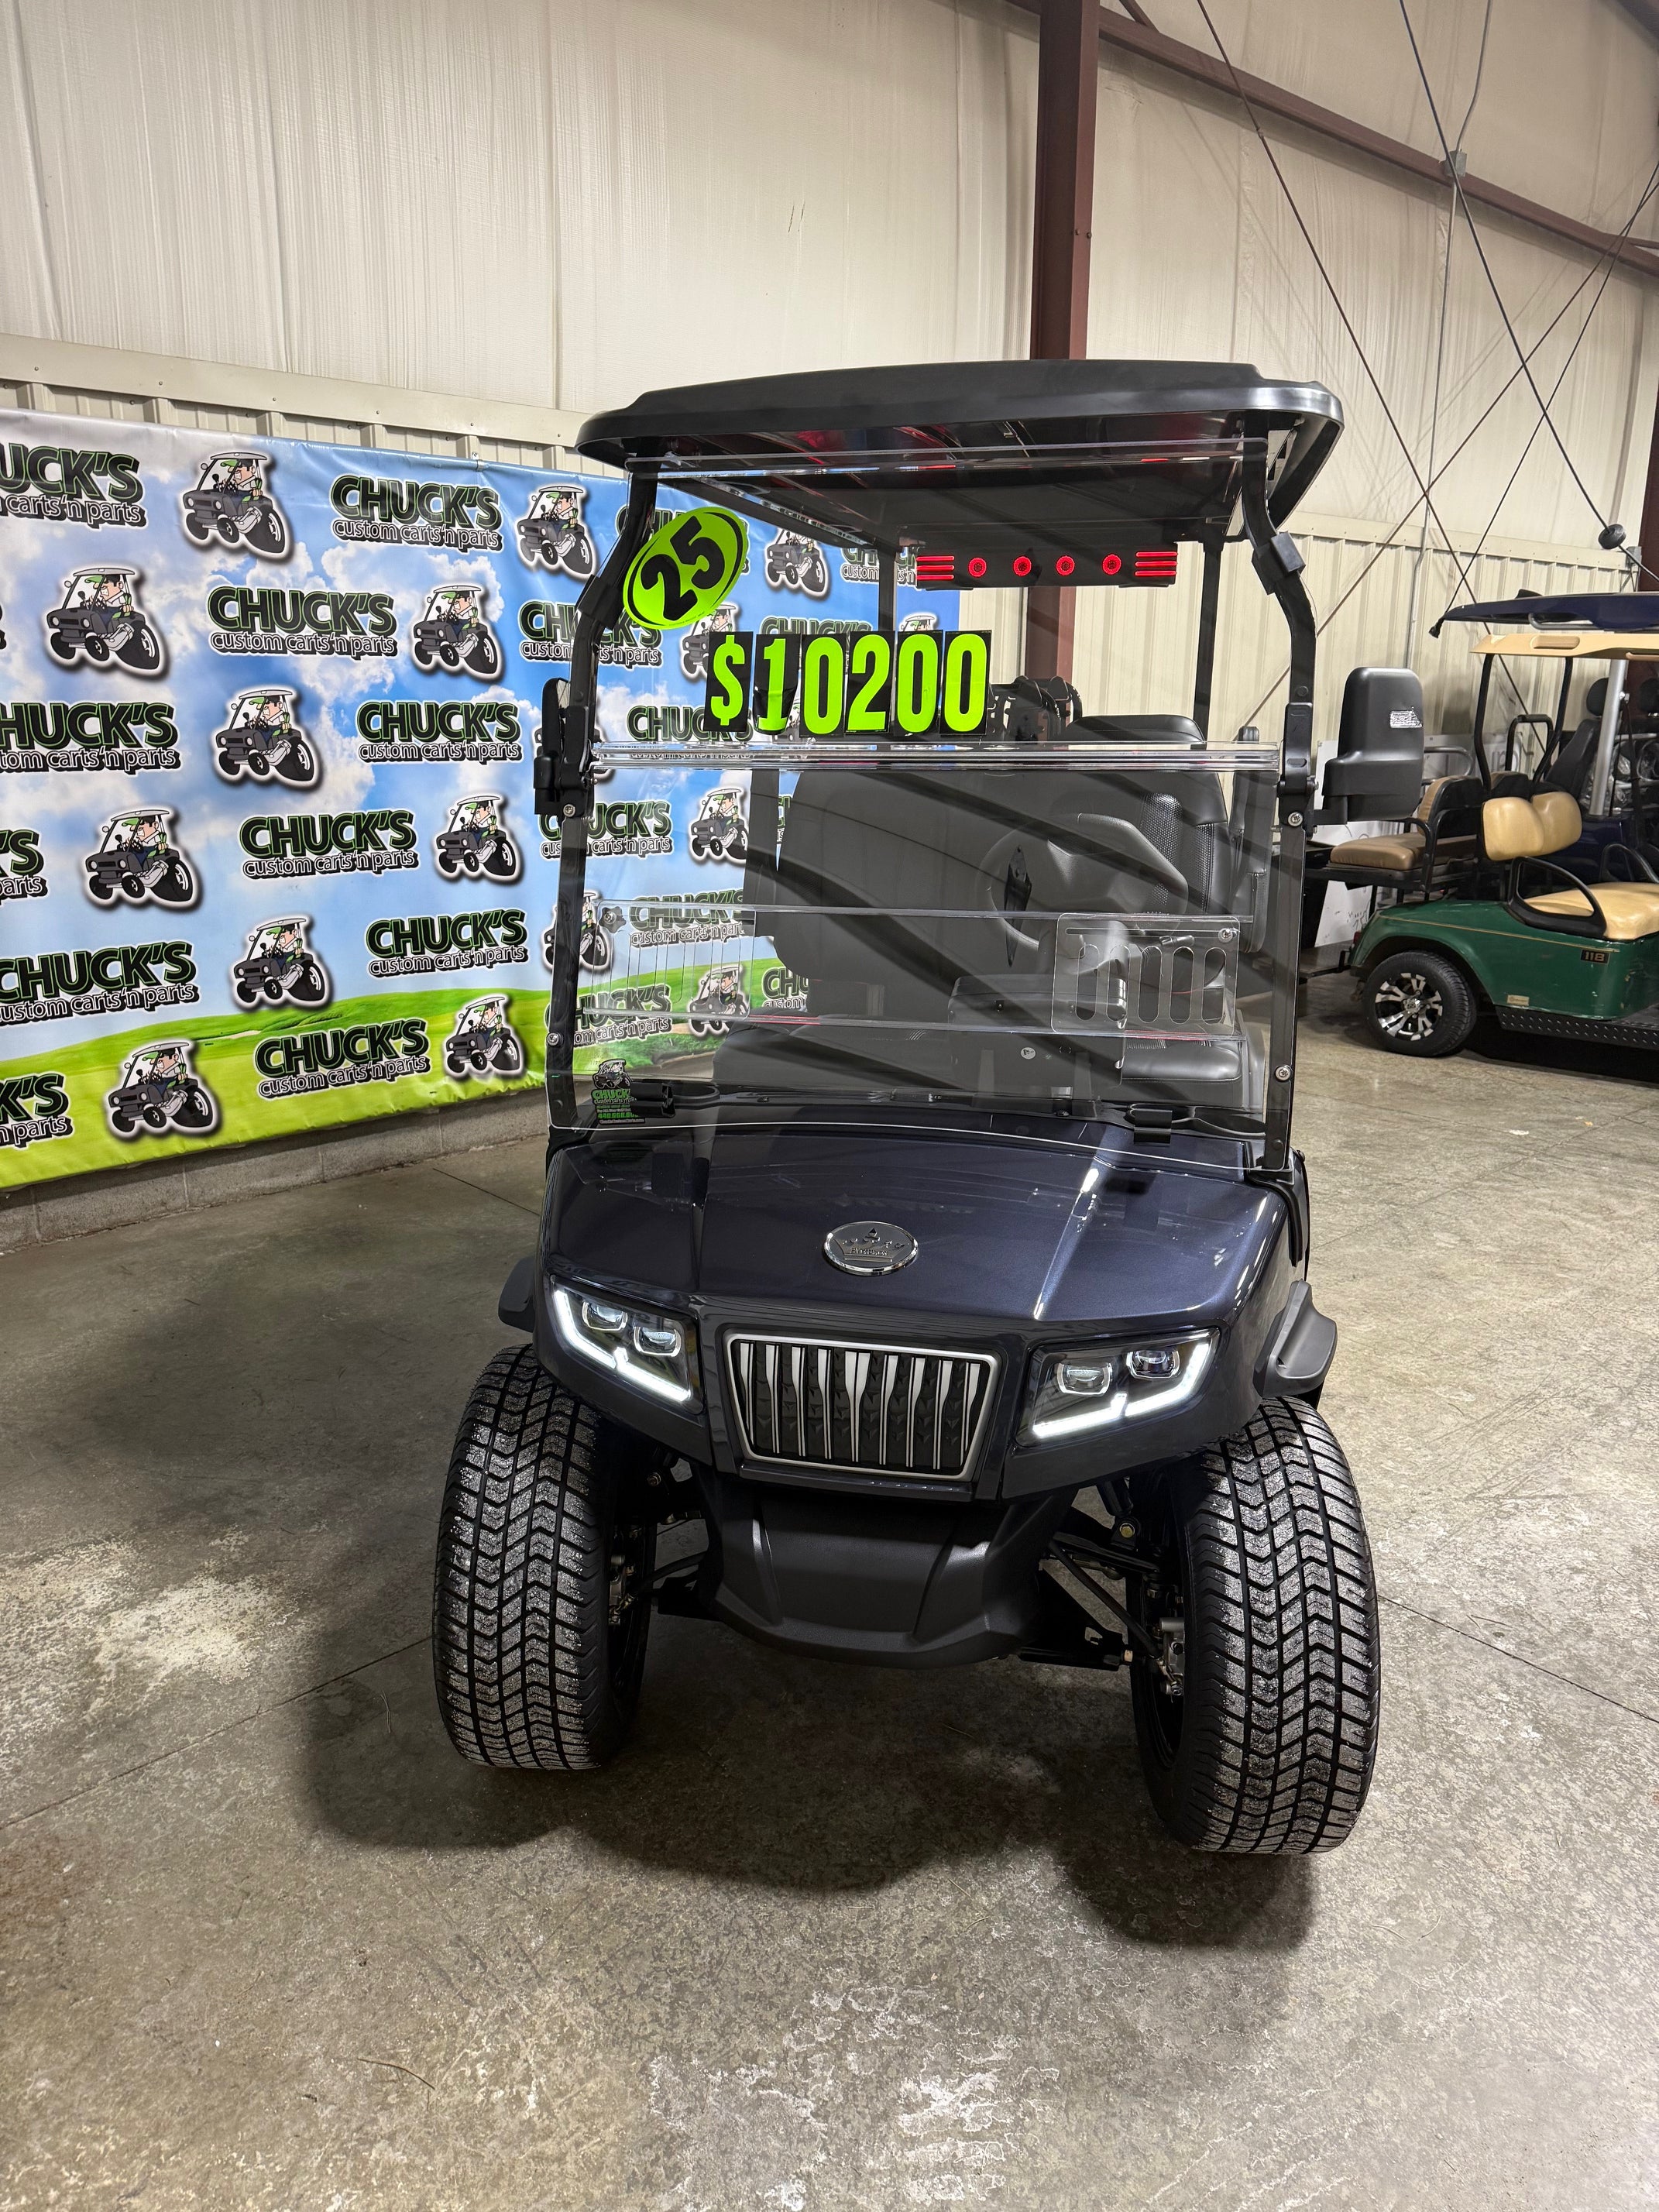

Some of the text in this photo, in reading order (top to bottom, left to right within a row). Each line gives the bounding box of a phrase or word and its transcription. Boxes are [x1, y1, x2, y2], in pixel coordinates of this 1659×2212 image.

[0, 443, 143, 503] UCK'S
[86, 500, 146, 529] parts
[331, 475, 502, 530] CHUCK'S
[333, 520, 400, 543] custom
[457, 529, 503, 551] parts
[641, 516, 725, 621] 25
[208, 586, 397, 636] CHUCK'S
[211, 632, 286, 654] custom
[349, 635, 397, 660] parts
[625, 646, 661, 668] parts
[711, 634, 988, 734] $10200
[0, 702, 178, 750] HUCK'S
[357, 702, 520, 742] CHUCK'S
[122, 747, 180, 774] parts
[359, 743, 421, 762] custom
[479, 742, 522, 764] parts
[239, 810, 417, 859] CHUCK'S
[639, 836, 672, 857] parts
[244, 857, 314, 879] custom
[372, 850, 419, 874] parts
[0, 874, 48, 900] arts
[366, 909, 527, 958] CHUCK'S
[631, 929, 678, 947] custom
[720, 922, 744, 943] part
[0, 941, 196, 1004] CHUCK'S
[369, 956, 435, 977] custom
[486, 946, 528, 969] parts
[0, 999, 72, 1026] ustom
[143, 983, 199, 1012] parts
[637, 1018, 672, 1039] parts
[256, 1018, 428, 1078] CHUCK'S
[259, 1072, 328, 1097] custom
[385, 1056, 431, 1081] parts
[12, 1116, 73, 1148] parts
